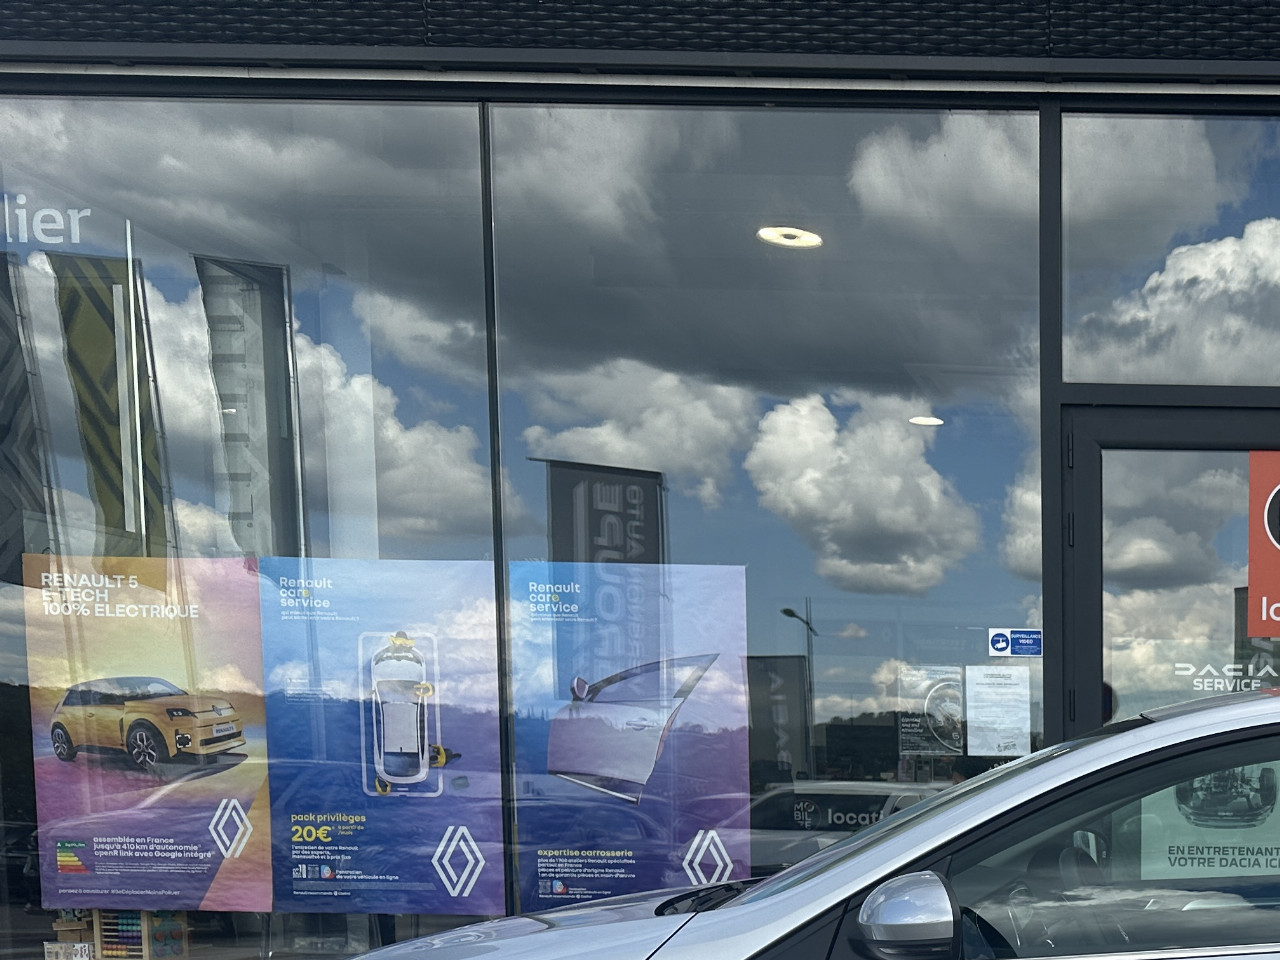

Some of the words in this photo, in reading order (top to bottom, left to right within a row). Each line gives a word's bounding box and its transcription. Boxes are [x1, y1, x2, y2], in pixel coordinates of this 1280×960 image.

[41, 573, 125, 588] RENAULT
[128, 575, 139, 589] 5
[280, 577, 333, 589] Renault
[280, 588, 310, 598] care
[528, 582, 581, 593] Renault
[42, 588, 108, 602] E-TECH
[529, 593, 560, 602] care
[280, 596, 331, 608] service
[529, 602, 579, 612] service
[43, 602, 91, 616] 100%
[94, 604, 199, 619] ELECTRIQUE
[1174, 663, 1279, 678] DACIA
[1192, 678, 1262, 692] SERVICE
[291, 812, 316, 823] pack
[317, 812, 367, 824] privilèges
[147, 837, 175, 845] France
[154, 851, 183, 860] Google
[537, 849, 581, 858] expertise
[581, 849, 633, 857] carrosserie
[1168, 845, 1186, 856] EN
[1167, 857, 1216, 868] VOTRE
[1219, 857, 1262, 869] DACIA
